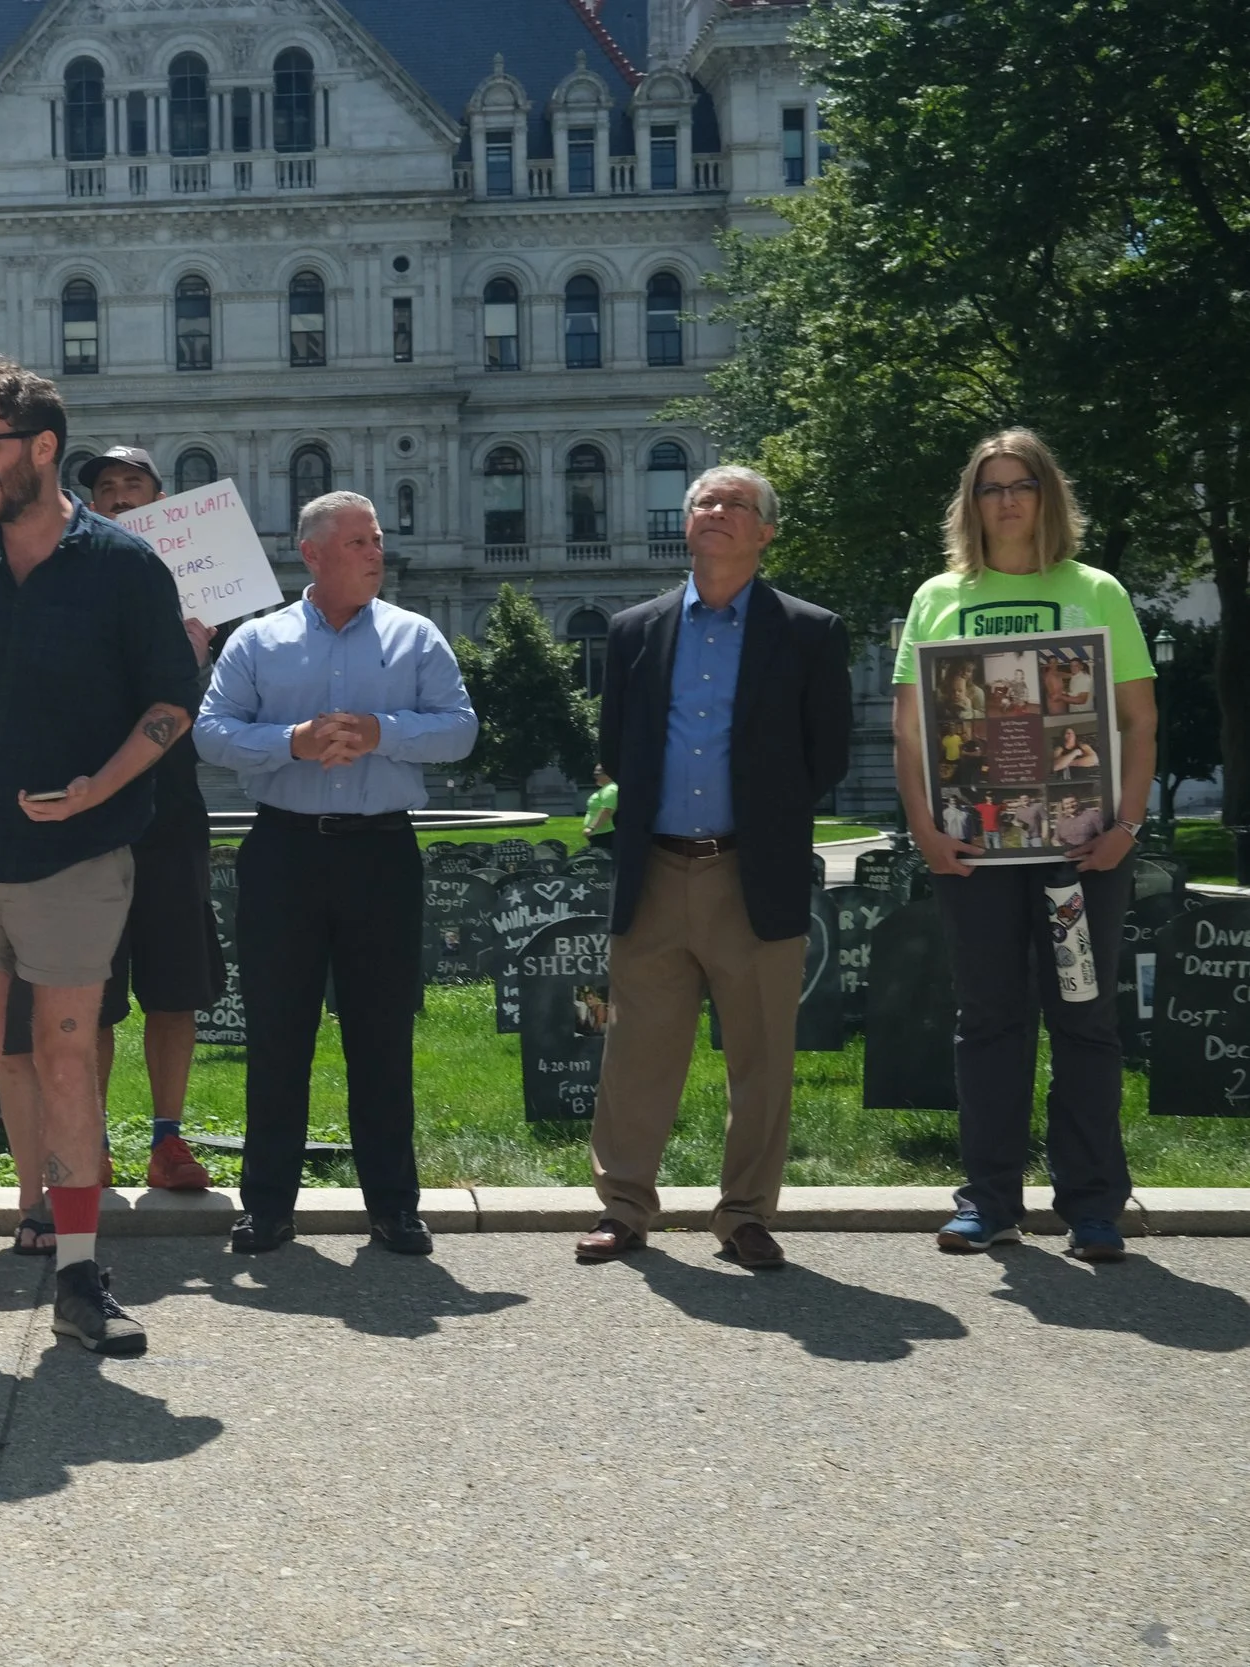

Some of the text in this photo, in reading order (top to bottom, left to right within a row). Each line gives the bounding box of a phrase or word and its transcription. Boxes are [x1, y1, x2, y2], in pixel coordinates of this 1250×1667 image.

[120, 514, 156, 535] HILE
[163, 505, 190, 524] YOU
[157, 528, 194, 554] DIE!
[201, 578, 244, 604] PILOT
[428, 879, 470, 896] Tony
